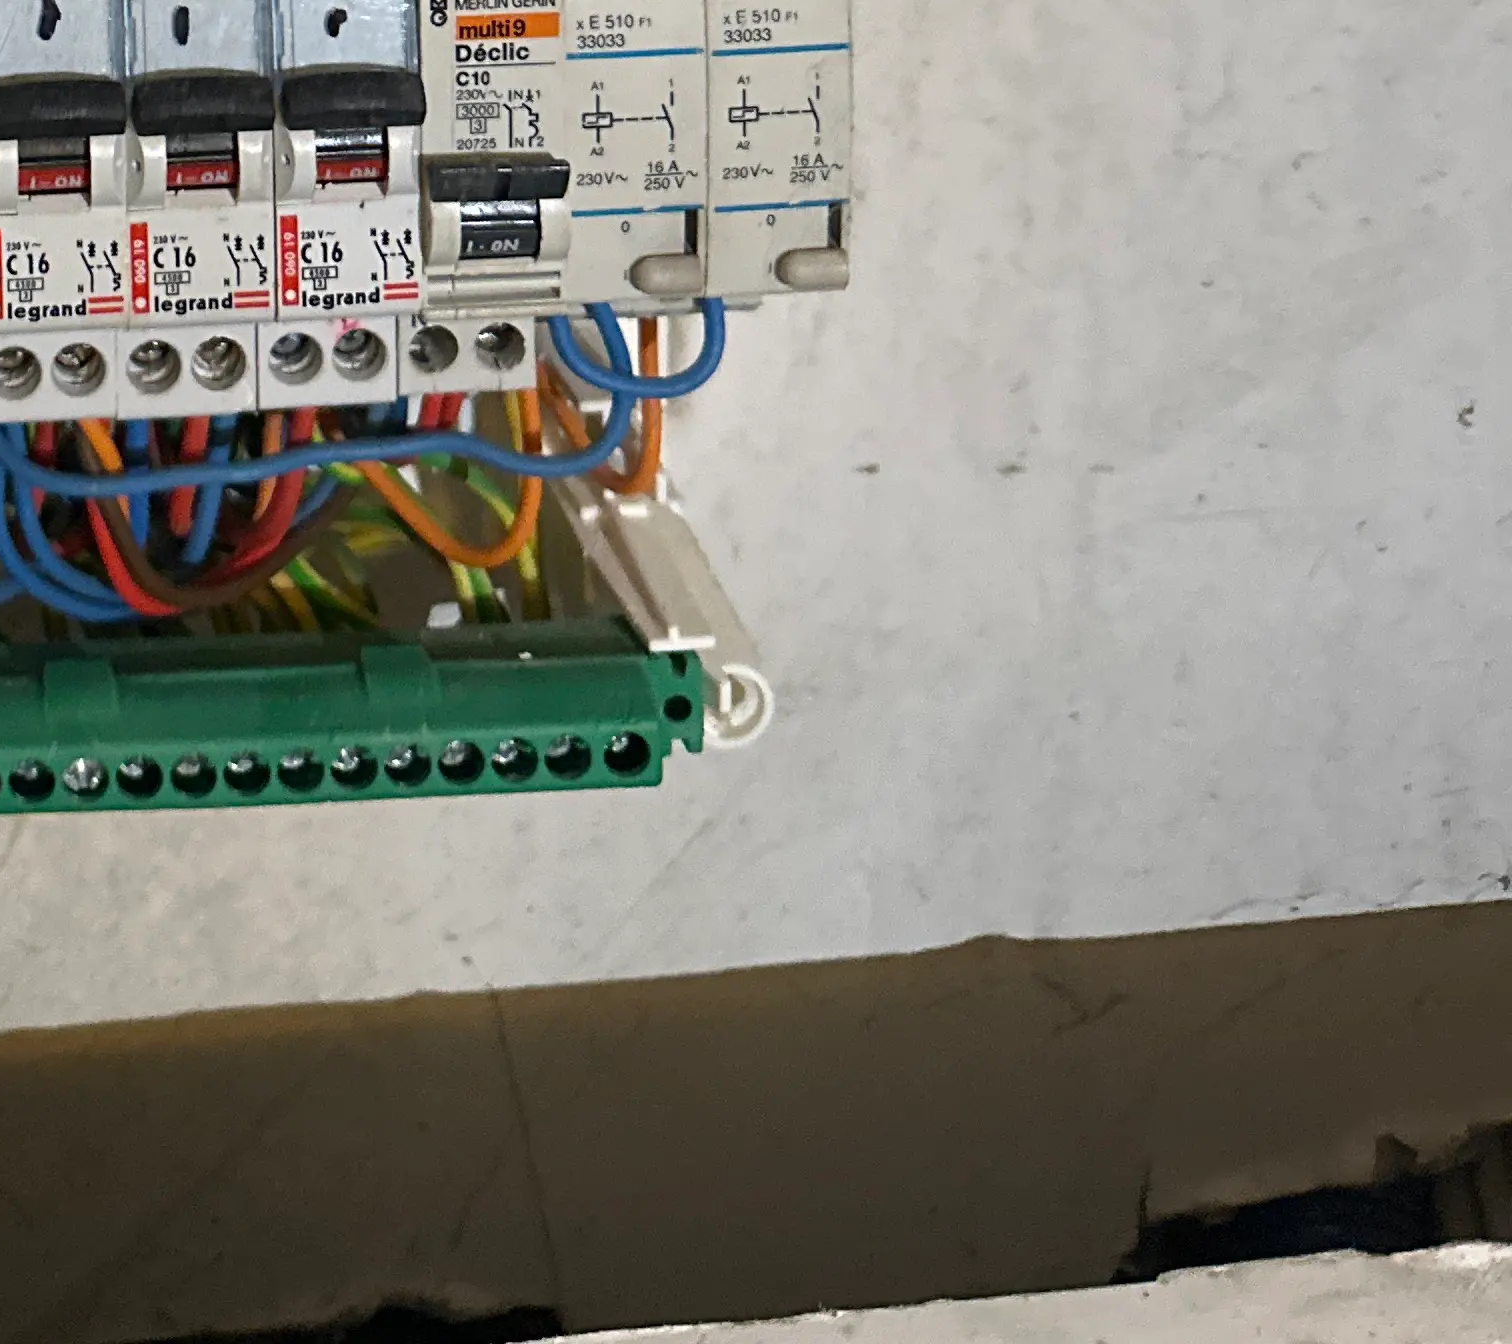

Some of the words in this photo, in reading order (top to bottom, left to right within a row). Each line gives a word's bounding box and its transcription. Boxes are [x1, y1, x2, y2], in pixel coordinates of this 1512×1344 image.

[605, 14, 633, 30] 510
[752, 8, 781, 24] 510
[576, 34, 625, 48] 33033
[723, 28, 772, 43] 33033
[455, 42, 530, 62] Déclic
[455, 70, 491, 87] C10
[456, 137, 497, 151] 20725
[172, 246, 197, 269] 16
[320, 241, 344, 264] 16
[25, 253, 51, 275] 16
[154, 291, 234, 316] legrand
[301, 286, 381, 310] legrand
[7, 299, 87, 323] legrand
